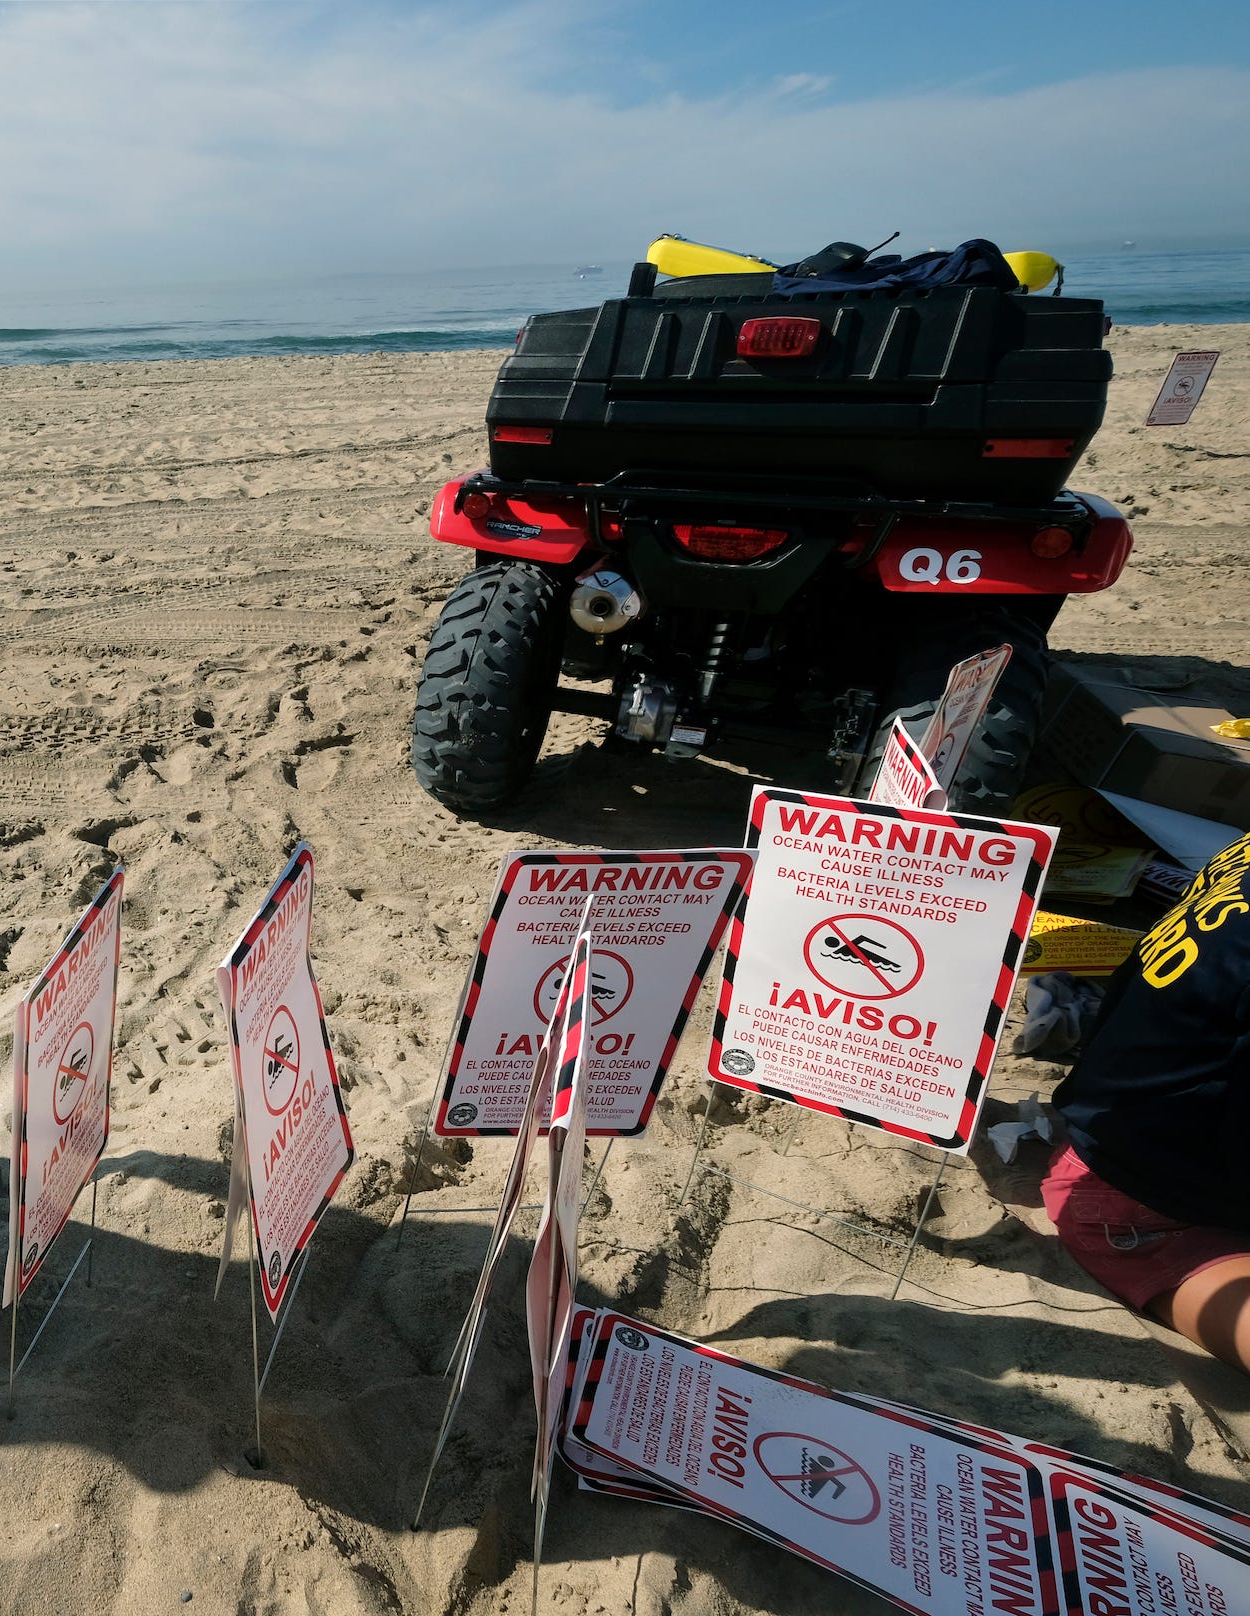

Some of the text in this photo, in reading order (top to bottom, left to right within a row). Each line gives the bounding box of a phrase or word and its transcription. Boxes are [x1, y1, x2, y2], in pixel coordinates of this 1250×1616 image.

[1178, 354, 1216, 362] WARNING
[486, 521, 541, 535] RANCHER
[899, 547, 983, 585] Q6
[773, 836, 1009, 882] OCEAN WATER CONTACT MAY
[779, 807, 1016, 866] WARNING
[518, 894, 714, 905] OCEAN CONTACT MAY
[528, 865, 726, 892] WARNING
[778, 867, 986, 912] BACTERIA LEVELS EXCEED
[821, 860, 944, 887] CAUSE ILLNESS
[241, 872, 308, 990] WARNING
[608, 908, 660, 917] ILLNESS
[638, 923, 691, 933] EXCEED
[796, 886, 957, 923] HEALTH STANDARDS
[1031, 925, 1079, 933] CAUSE
[36, 896, 116, 1023] WARNING
[738, 1004, 962, 1068] EL CONTACTO CON AGUA DEL OCEANO
[770, 982, 937, 1046] ¡AVISO!
[466, 1060, 650, 1069] EL CONTACTO OCEANO
[734, 1030, 955, 1098] LOS NIVELES DE BACTERIAS EXCEDEN
[753, 1020, 939, 1077] PUEDE CAUSAR ENFERMEDADES
[756, 1049, 778, 1062] LOS
[781, 1056, 857, 1084] ESTANDARES
[861, 1078, 877, 1090] DE
[880, 1084, 921, 1102] SALUD
[596, 1085, 642, 1094] EXCEDEN
[263, 1069, 318, 1182] ¡AVISO!
[709, 1386, 752, 1489] ¡AVISO!
[888, 1452, 907, 1569] HEALTH STANDARDS
[910, 1443, 932, 1597] BACTERIA LEVELS EXCEED
[936, 1484, 957, 1578] CAUSE ILLNESS
[956, 1453, 983, 1602] OCEAN WATER CONTACT
[981, 1466, 1035, 1616] WARNIN
[1074, 1498, 1132, 1616] RNING
[1124, 1516, 1155, 1613] CONTACT MAY
[1177, 1552, 1204, 1609] EXCEED
